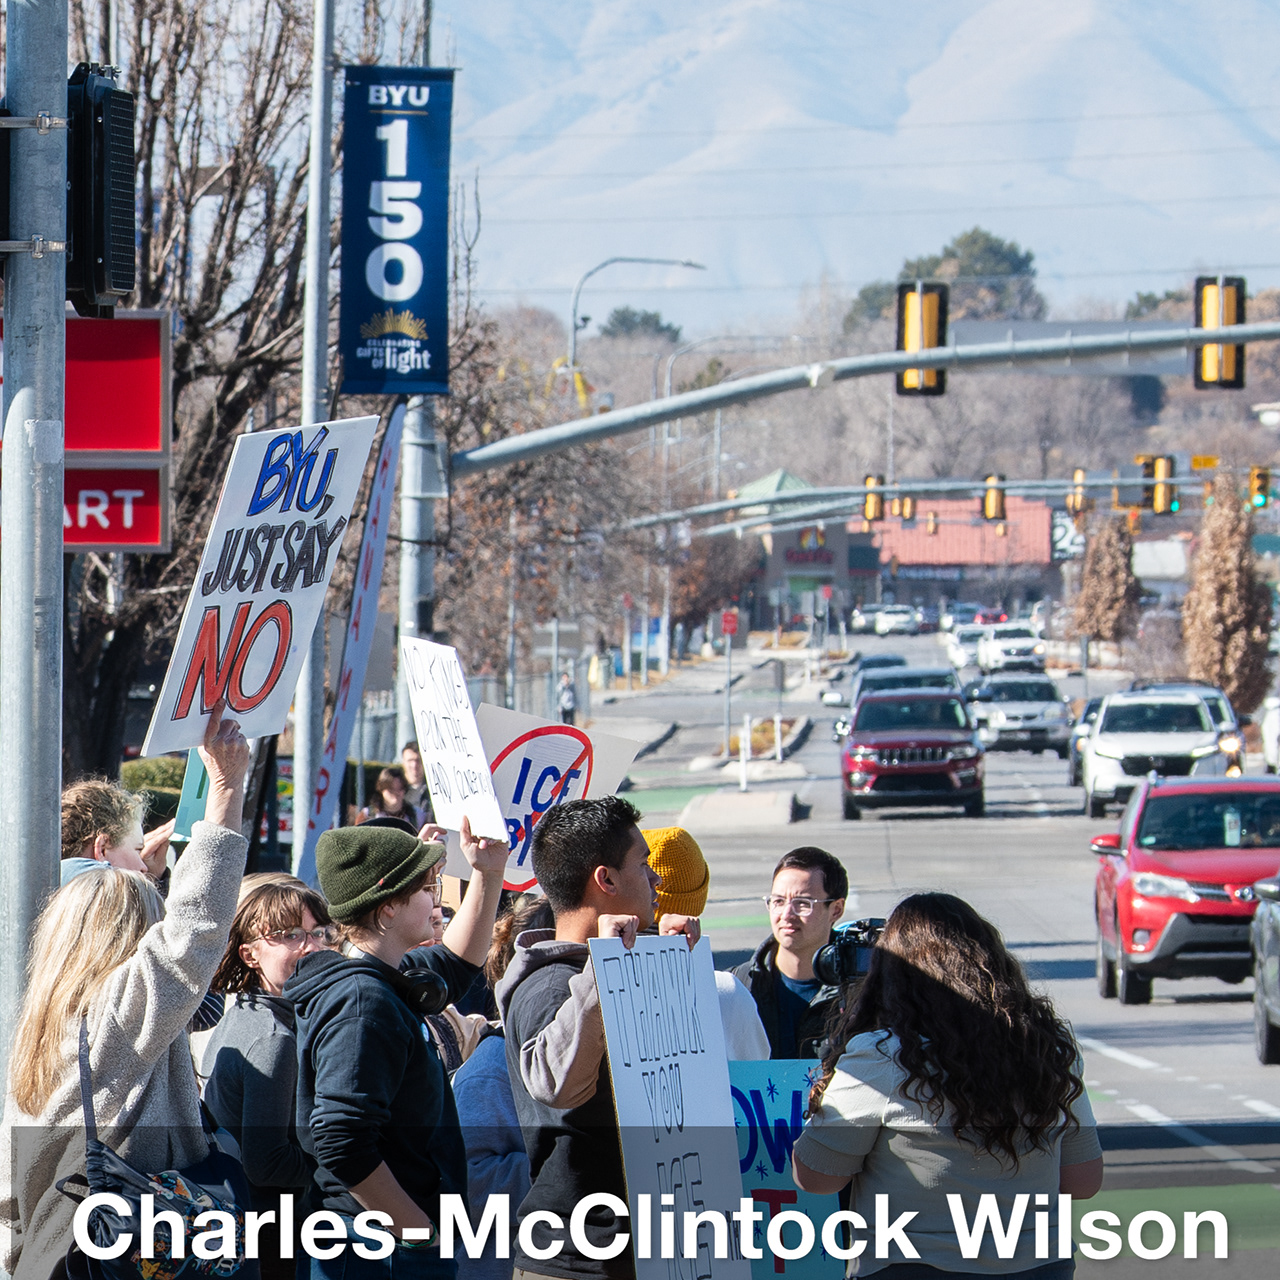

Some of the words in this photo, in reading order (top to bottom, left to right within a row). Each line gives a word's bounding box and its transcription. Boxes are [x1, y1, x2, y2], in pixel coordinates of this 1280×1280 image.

[368, 85, 430, 106] BYU
[385, 346, 432, 374] light
[246, 425, 339, 520] BYU,
[202, 522, 286, 597] JUST
[270, 515, 347, 594] SAY
[171, 599, 293, 721] NO
[603, 947, 706, 1068] THANK
[642, 1063, 685, 1144] YOU
